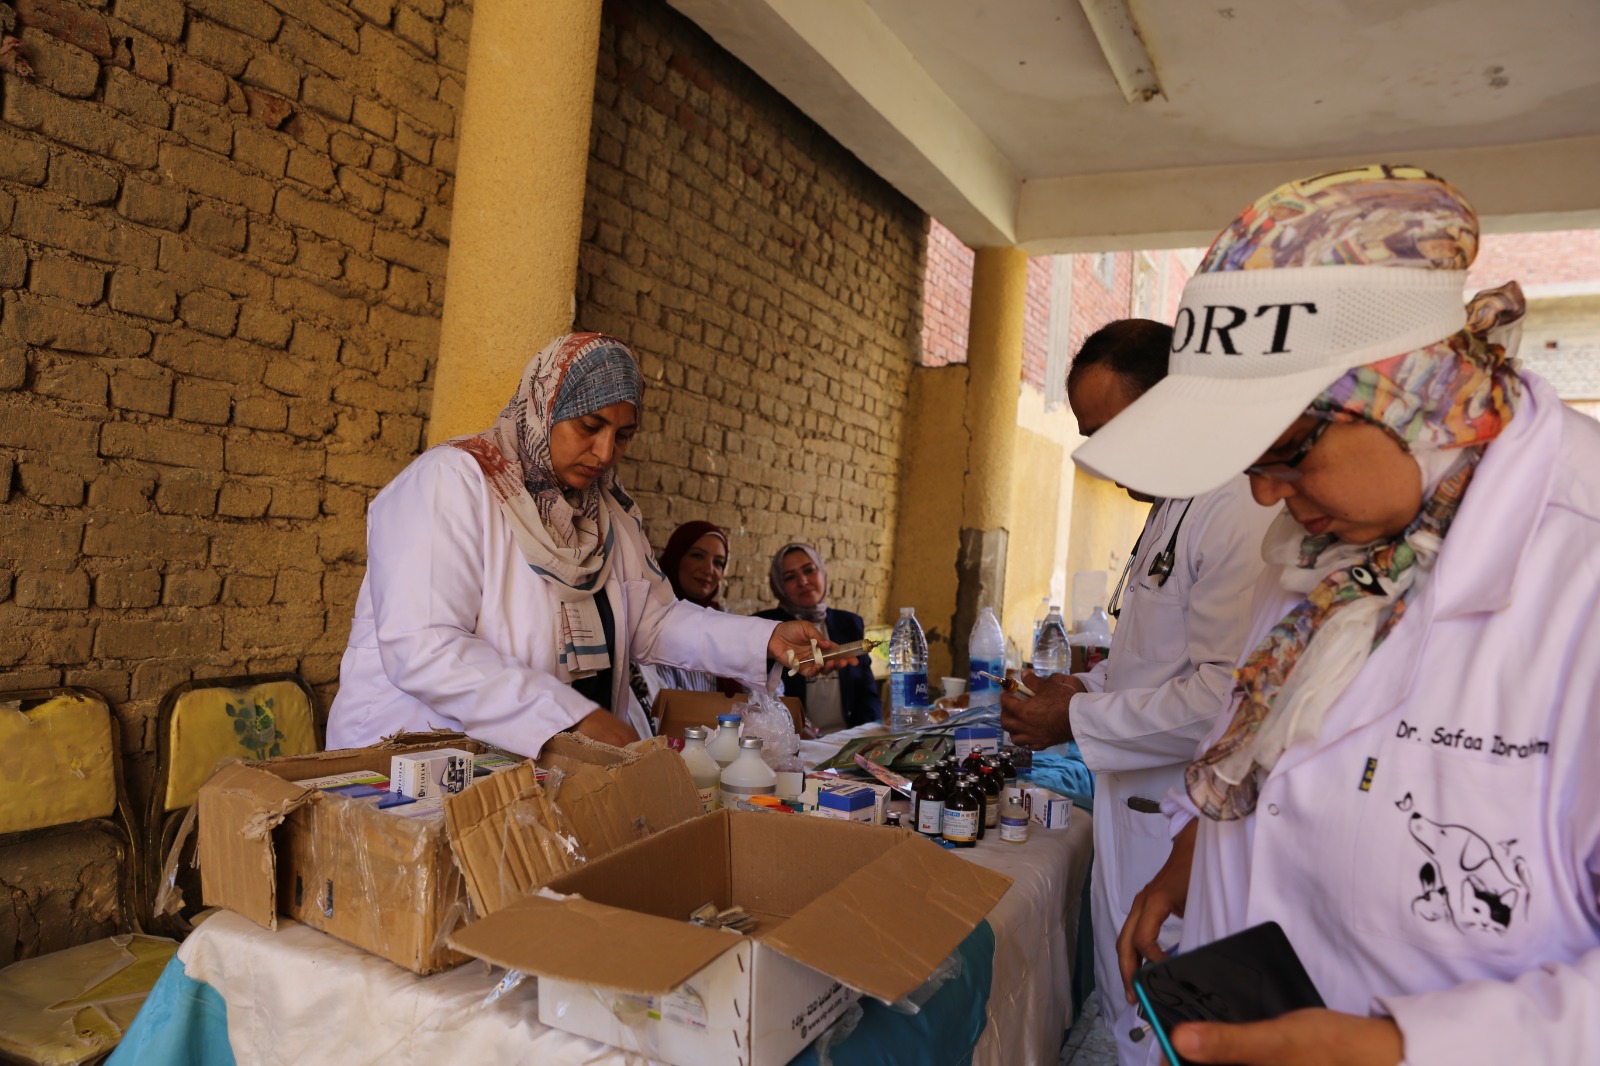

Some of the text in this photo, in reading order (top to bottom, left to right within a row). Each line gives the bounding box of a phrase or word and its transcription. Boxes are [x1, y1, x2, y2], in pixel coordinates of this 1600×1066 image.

[1171, 302, 1318, 356] ORT
[1396, 720, 1422, 742] Dr.
[1431, 726, 1483, 751] Safaa
